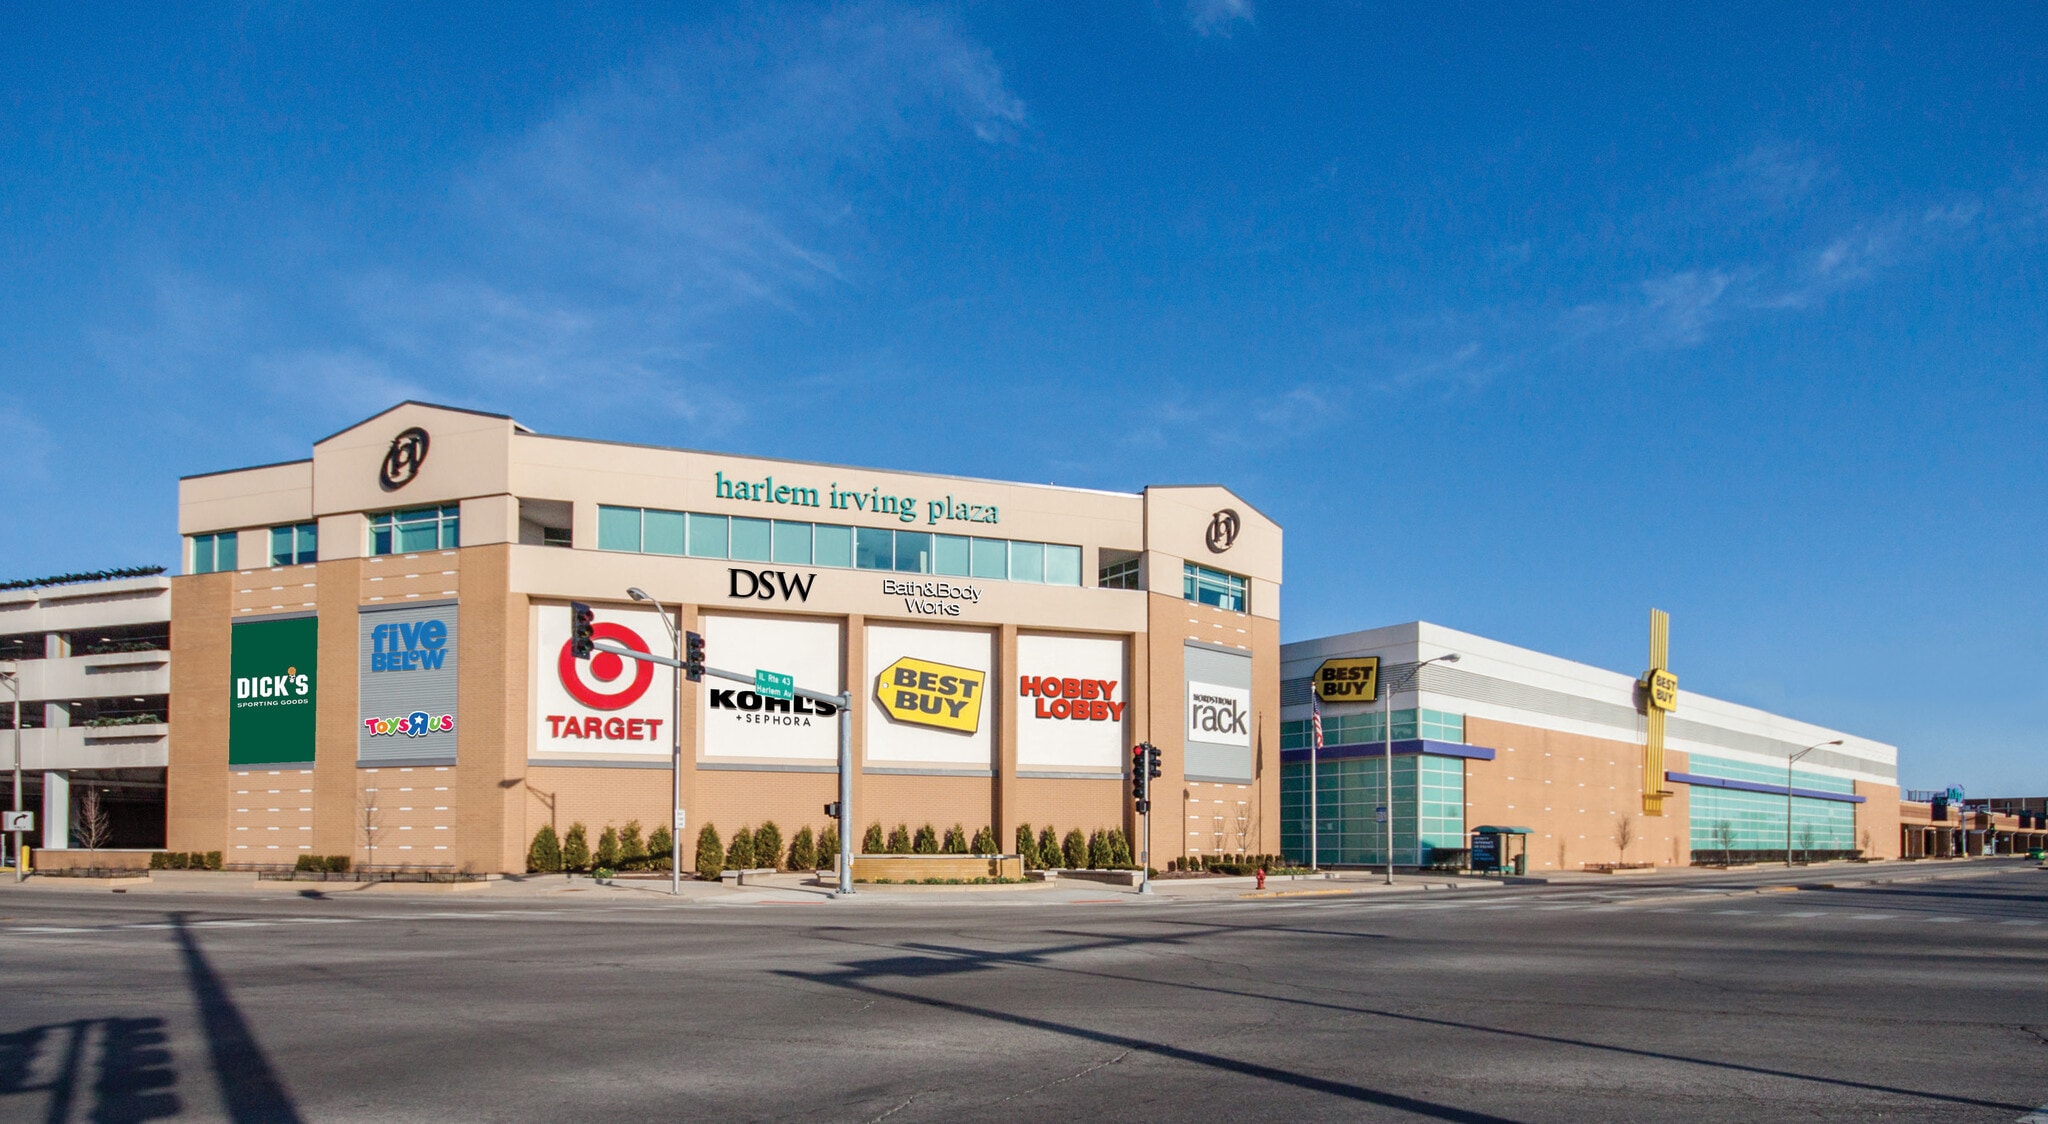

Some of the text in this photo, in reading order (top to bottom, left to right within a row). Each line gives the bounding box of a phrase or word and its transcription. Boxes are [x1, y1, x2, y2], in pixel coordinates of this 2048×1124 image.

[715, 470, 1001, 525] harlem irving plaza
[727, 567, 818, 603] DSW
[883, 578, 984, 604] Bath&Body
[904, 597, 961, 616] Works
[371, 619, 449, 654] five
[236, 667, 309, 699] DICK'S
[758, 672, 791, 686] IL Rte 43
[893, 667, 979, 699] BEST
[1322, 666, 1373, 681] BEST
[1656, 675, 1676, 692] BEST
[756, 685, 781, 697] Harlem
[1020, 675, 1118, 700] HOBBY
[1193, 693, 1233, 706] NORDSTROM
[1323, 681, 1368, 696] BUY
[1656, 688, 1673, 704] BUY
[894, 690, 969, 719] BUY
[1035, 698, 1127, 721] LOBBY
[545, 714, 663, 742] TARGET
[746, 713, 811, 727] SEPHORA
[1193, 699, 1248, 735] rack
